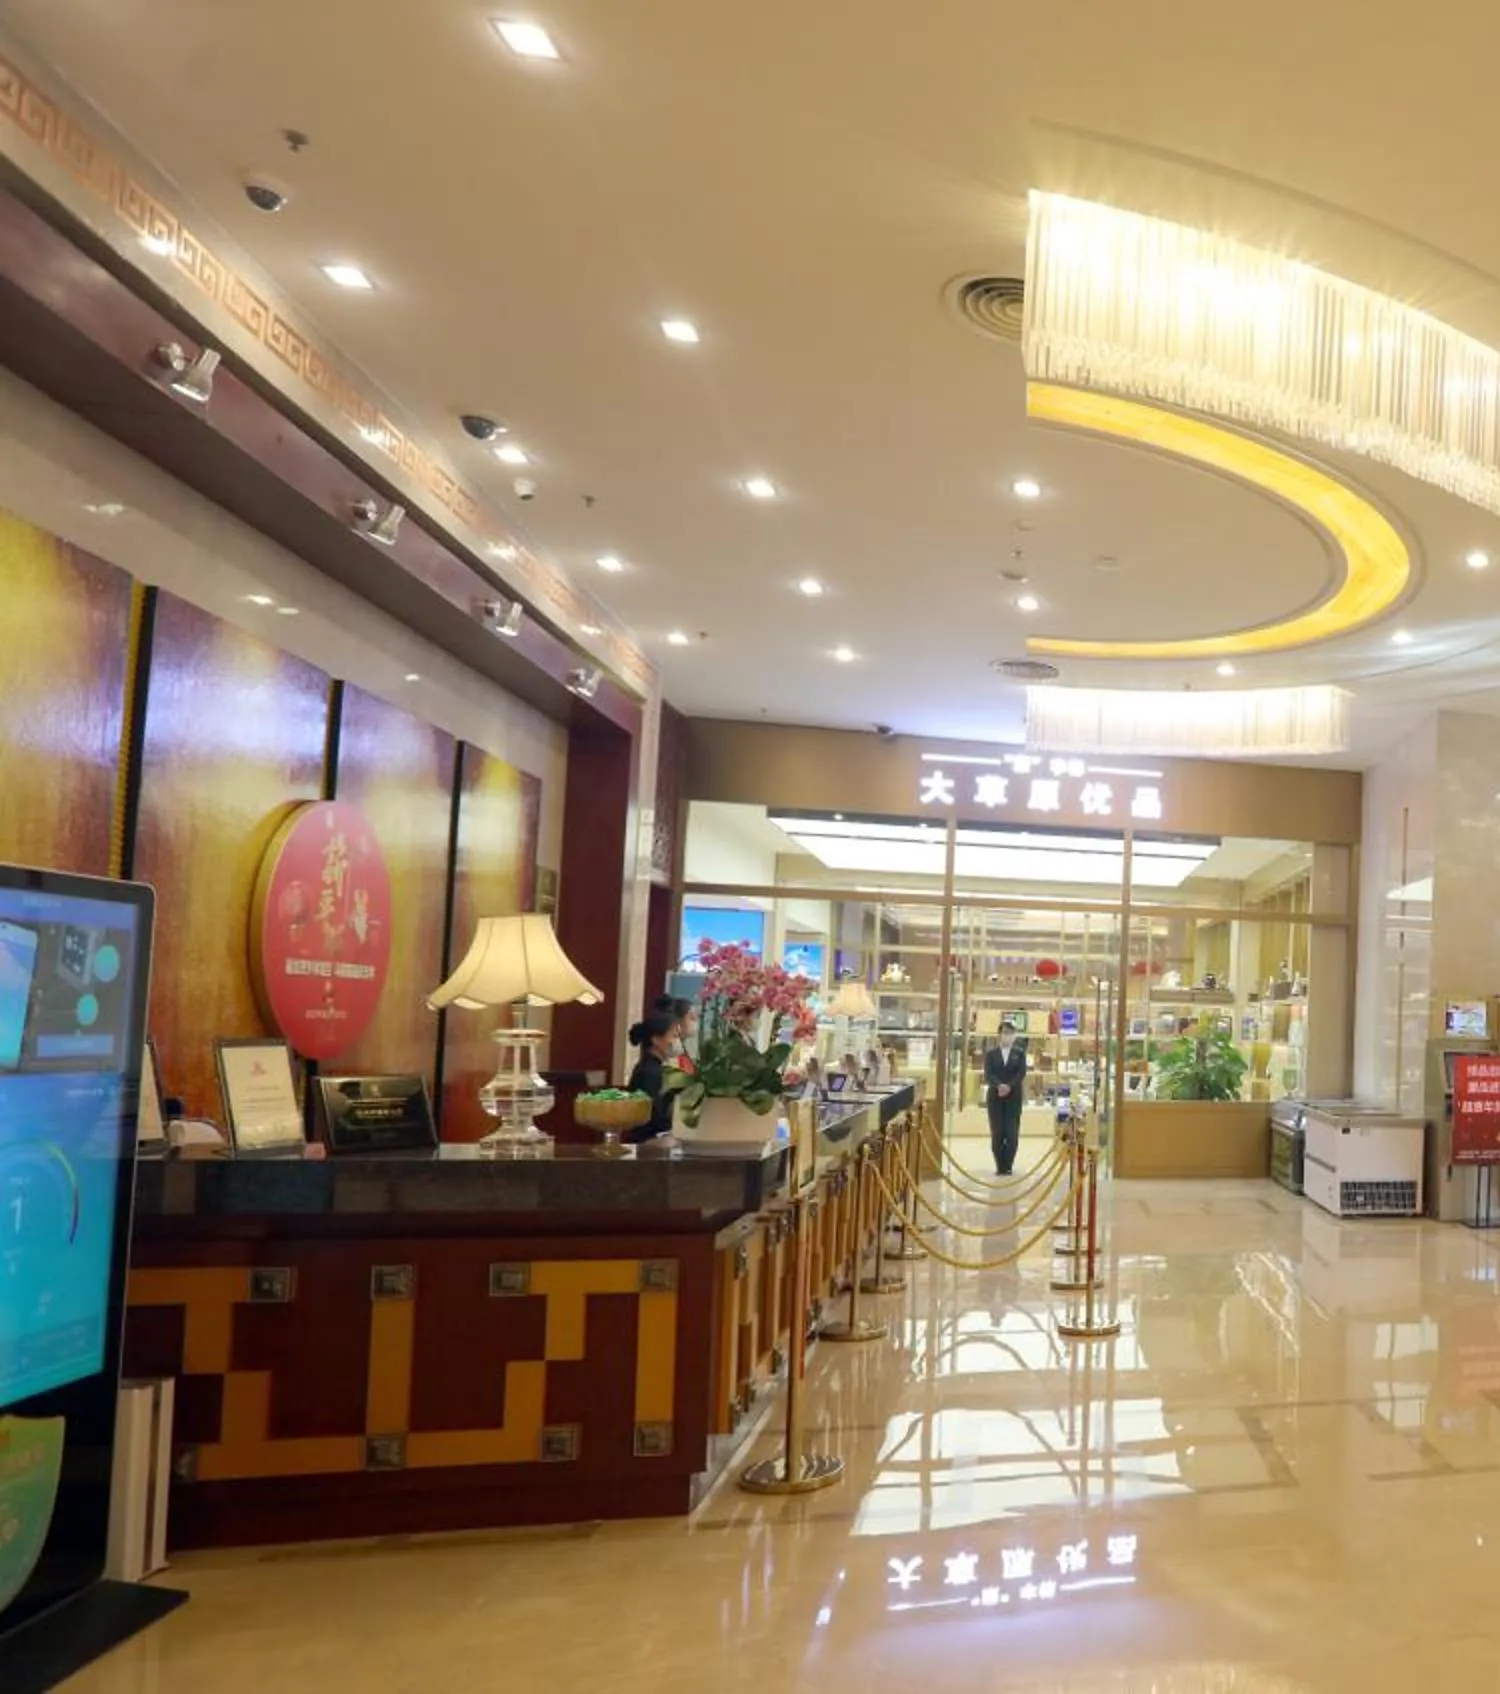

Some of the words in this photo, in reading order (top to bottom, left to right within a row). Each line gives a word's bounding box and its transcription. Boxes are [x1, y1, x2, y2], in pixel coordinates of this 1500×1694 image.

[919, 770, 1163, 819] 大草原优品
